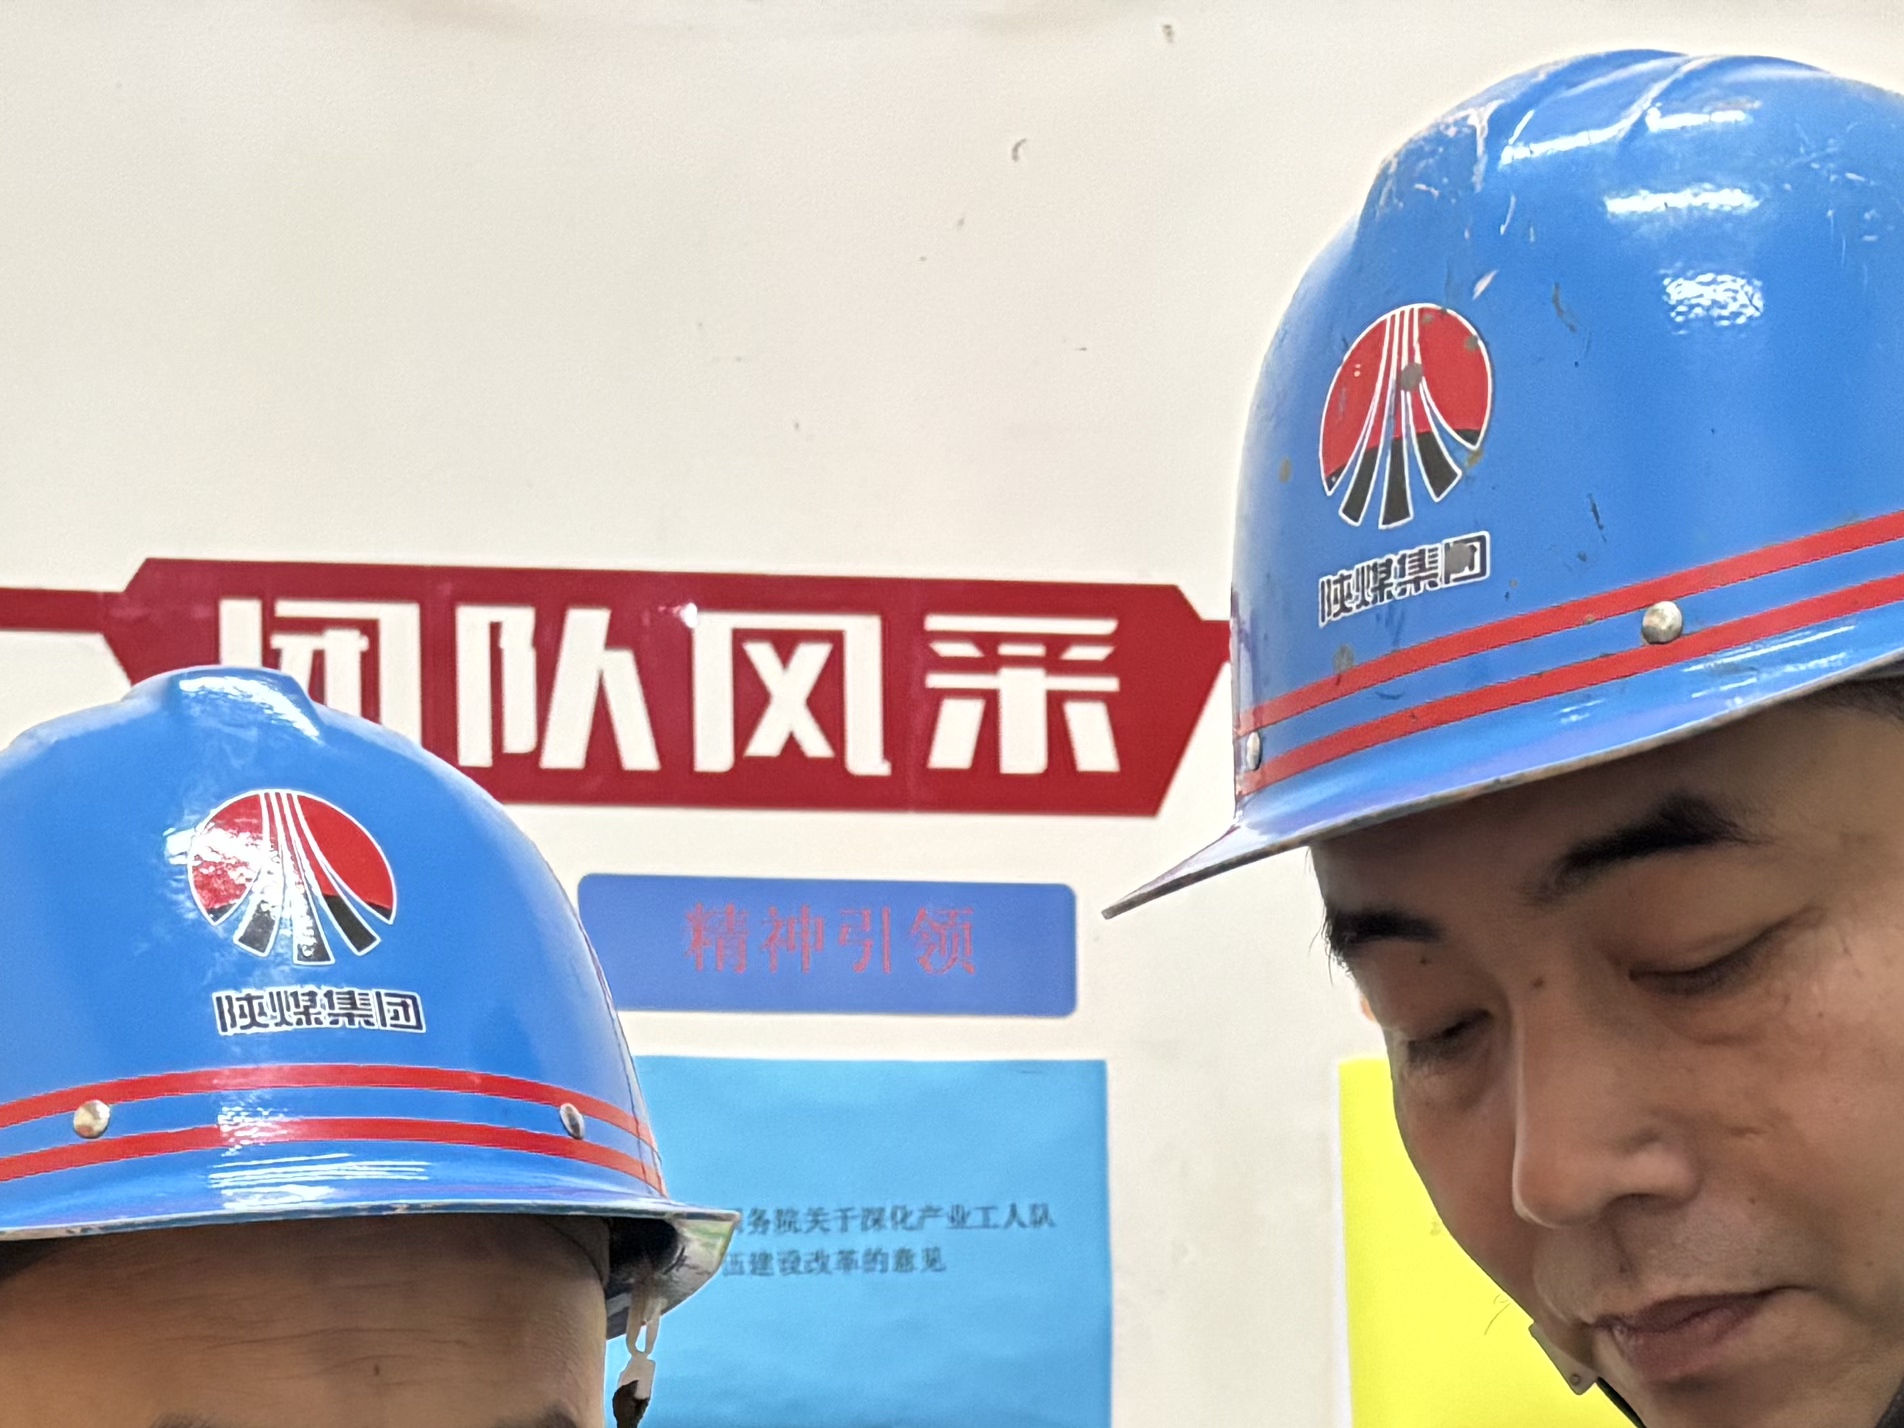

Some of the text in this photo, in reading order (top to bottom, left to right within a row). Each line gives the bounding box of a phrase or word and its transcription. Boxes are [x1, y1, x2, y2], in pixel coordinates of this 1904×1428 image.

[1319, 530, 1490, 628] 陕煤集团
[684, 902, 979, 978] 精神引领
[215, 984, 426, 1036] 陕煤集团
